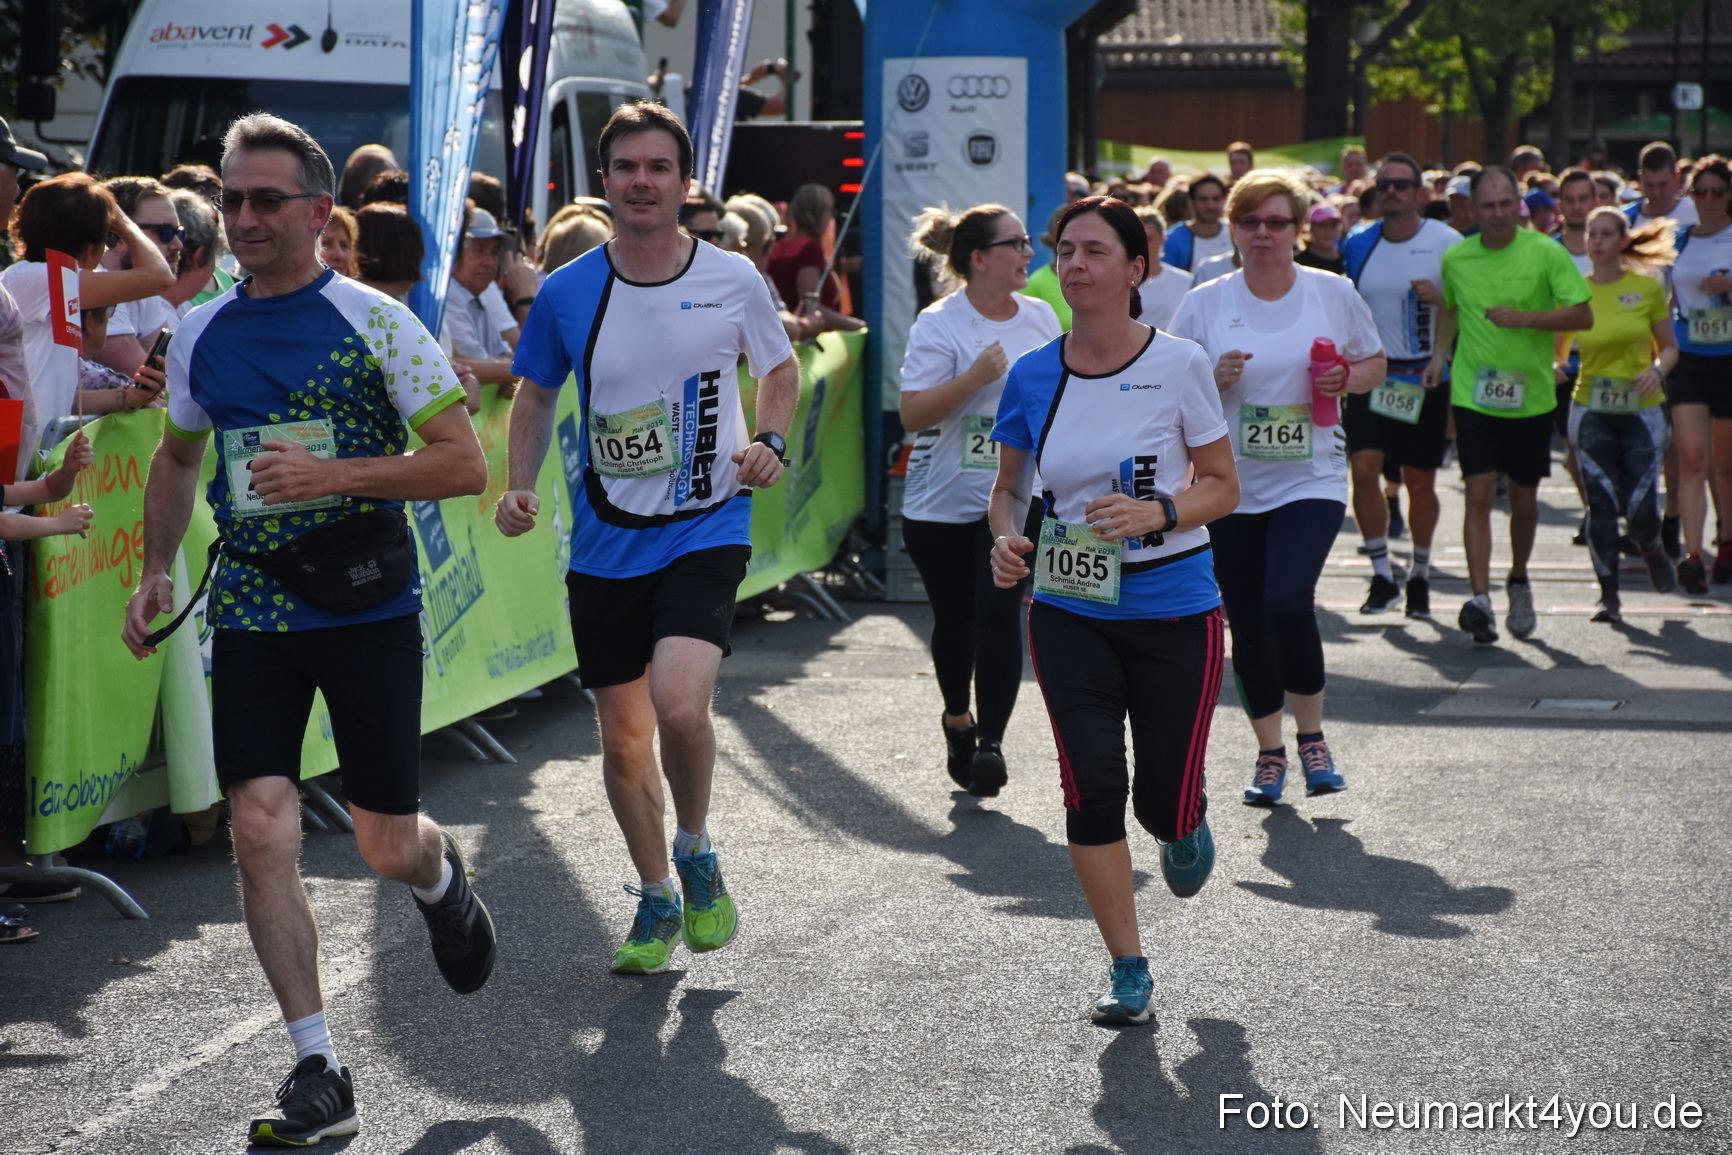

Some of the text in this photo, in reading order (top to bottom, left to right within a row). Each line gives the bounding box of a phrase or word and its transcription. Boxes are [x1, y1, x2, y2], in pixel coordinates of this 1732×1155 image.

[149, 22, 254, 43] abavent
[949, 104, 977, 113] Audi
[894, 162, 938, 172] SEAT
[1694, 319, 1729, 335] 1051
[1485, 381, 1515, 398] 664
[1379, 391, 1415, 412] 1058
[1601, 391, 1629, 405] 671
[646, 419, 663, 429] 2019
[671, 402, 680, 433] WASTE
[686, 370, 720, 502] HUBER
[1248, 424, 1304, 444] 2164
[305, 443, 327, 452] 2019
[595, 429, 663, 462] 1054
[676, 401, 696, 501] TECHNOLOGY
[971, 434, 996, 454] 21
[600, 455, 664, 468] Schimpl Christoph
[1111, 478, 1120, 494] WAS
[1098, 547, 1116, 556] 2019
[348, 563, 365, 574] Jack
[1045, 546, 1108, 582] 1055
[350, 567, 380, 580] Wolfskin
[1050, 575, 1101, 589] Schmid Andrea
